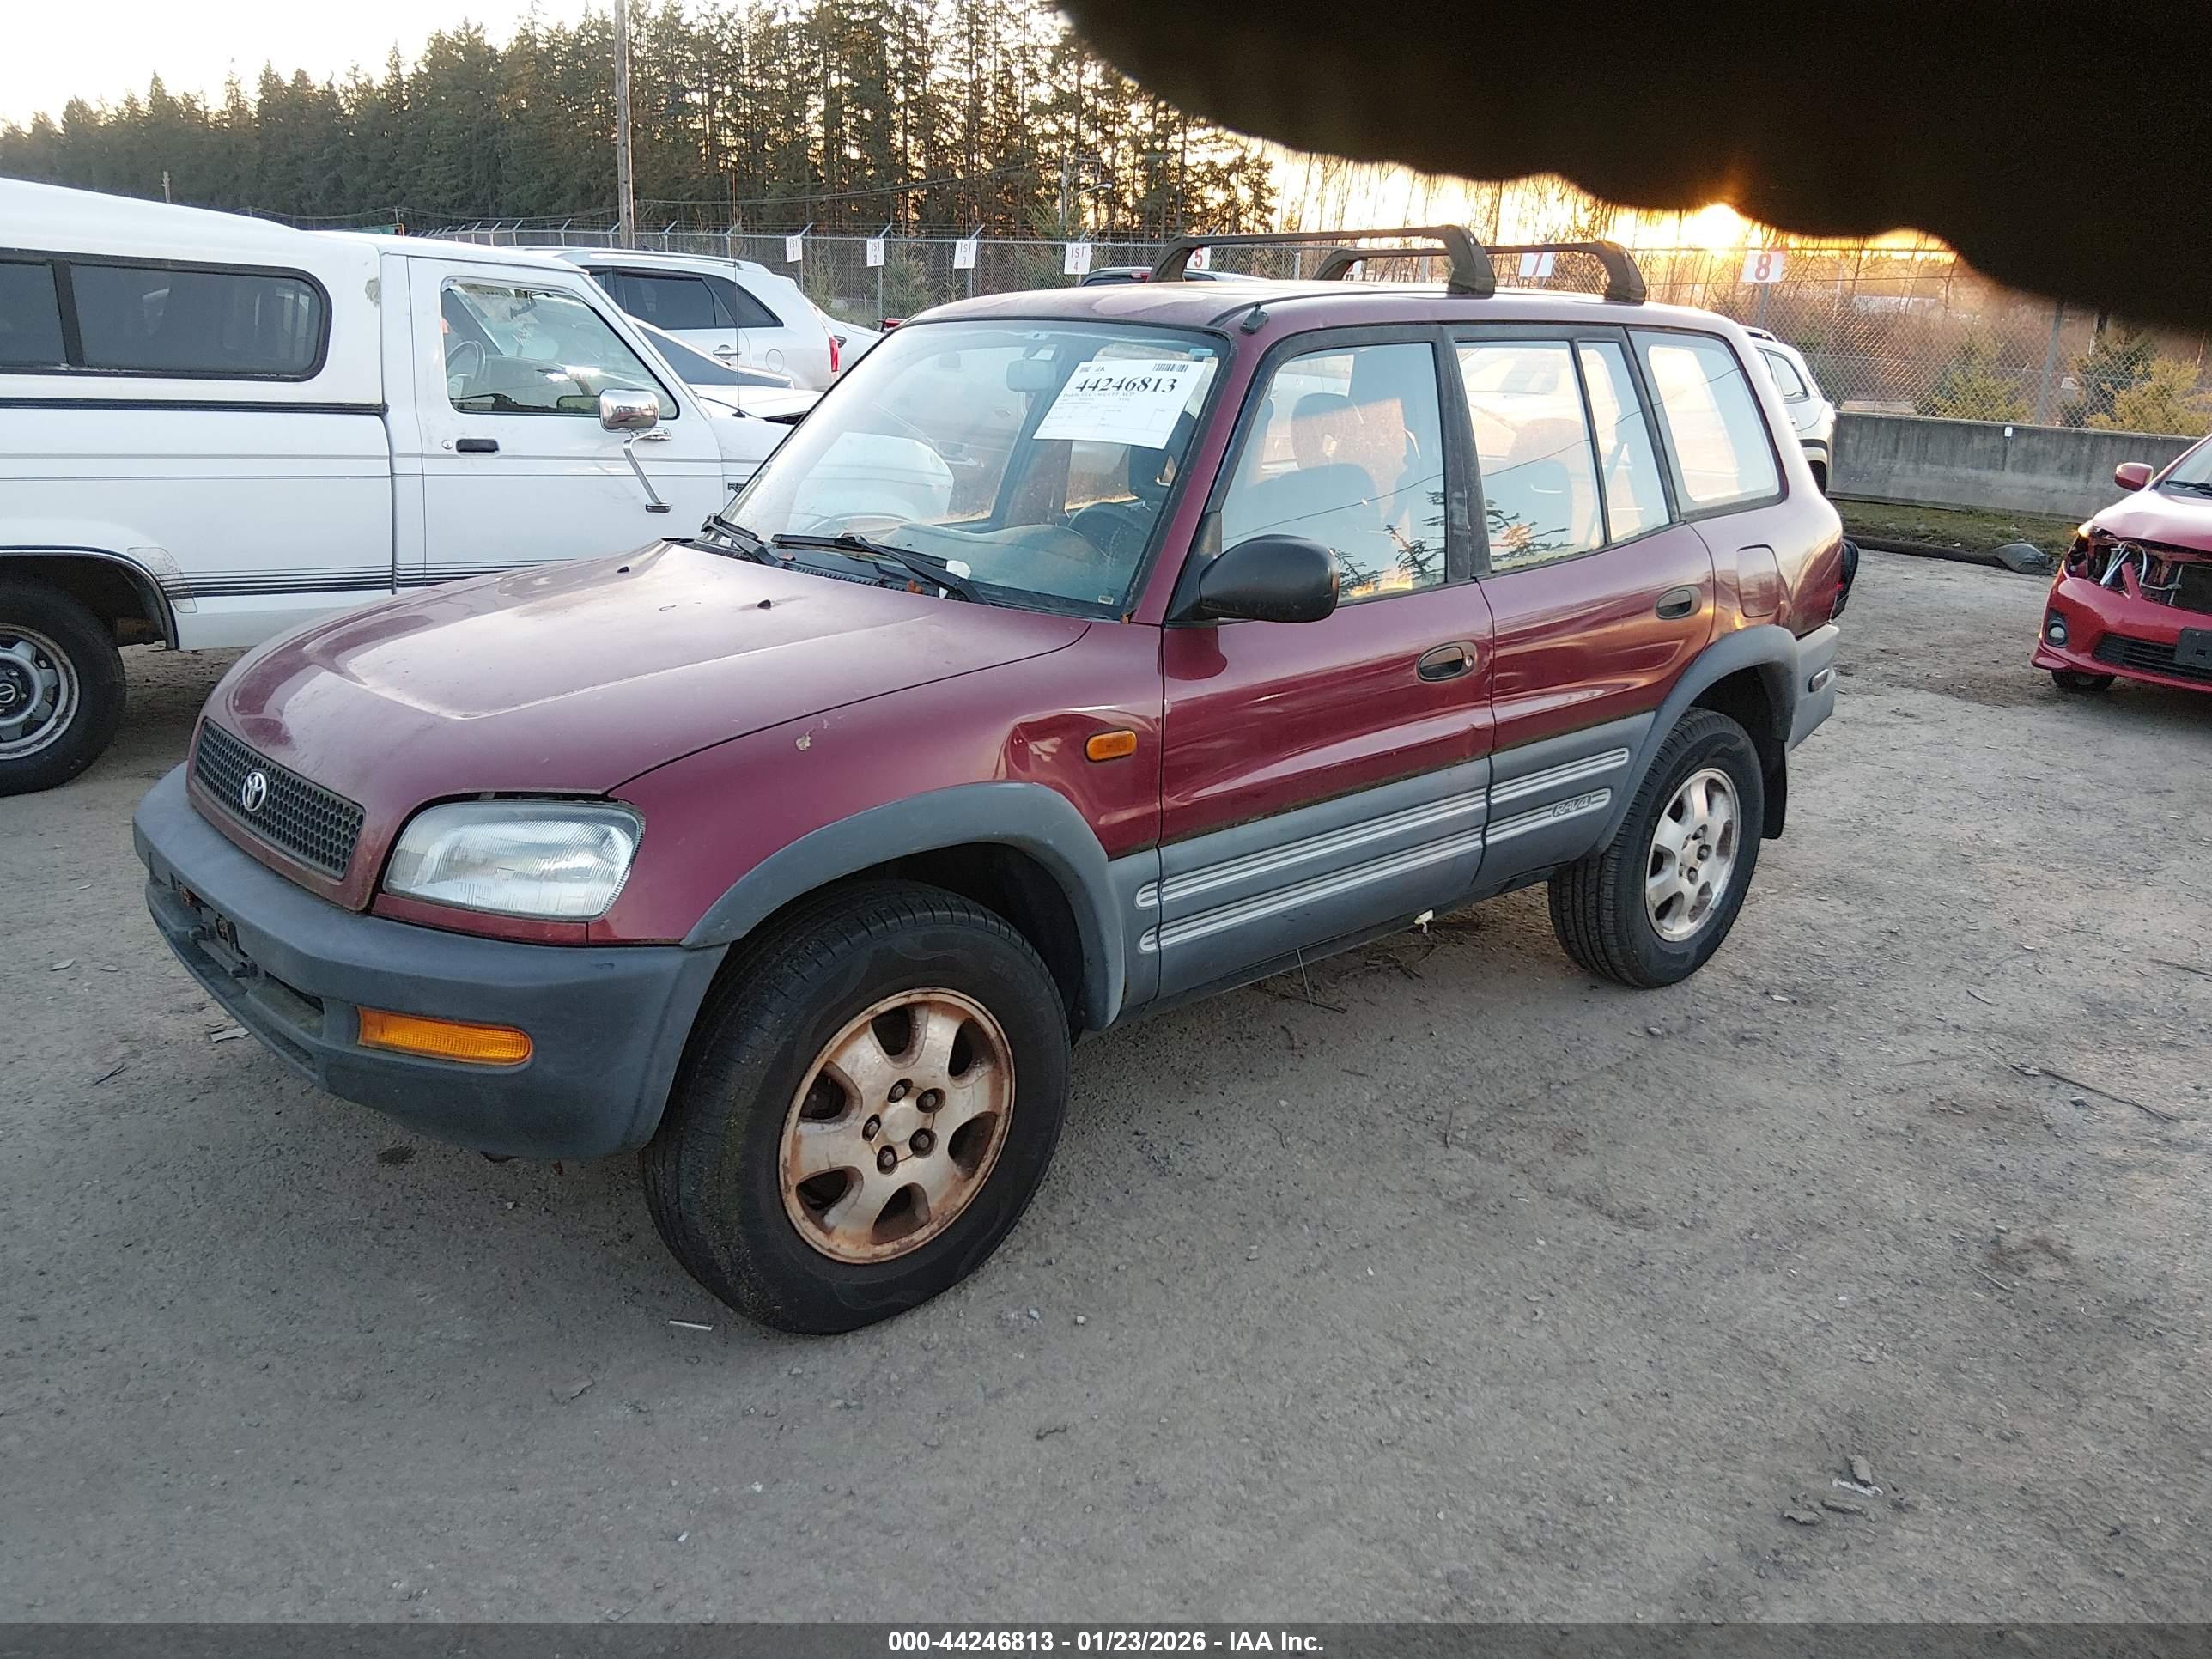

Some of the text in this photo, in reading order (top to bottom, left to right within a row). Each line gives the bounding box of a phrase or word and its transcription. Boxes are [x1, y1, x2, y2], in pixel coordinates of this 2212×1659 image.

[873, 254, 878, 264] 2
[1073, 261, 1079, 272] 4
[1194, 247, 1203, 268] 5
[1754, 253, 1771, 281] 8
[1075, 376, 1178, 393] 44246813
[1553, 796, 1589, 817] RAV4
